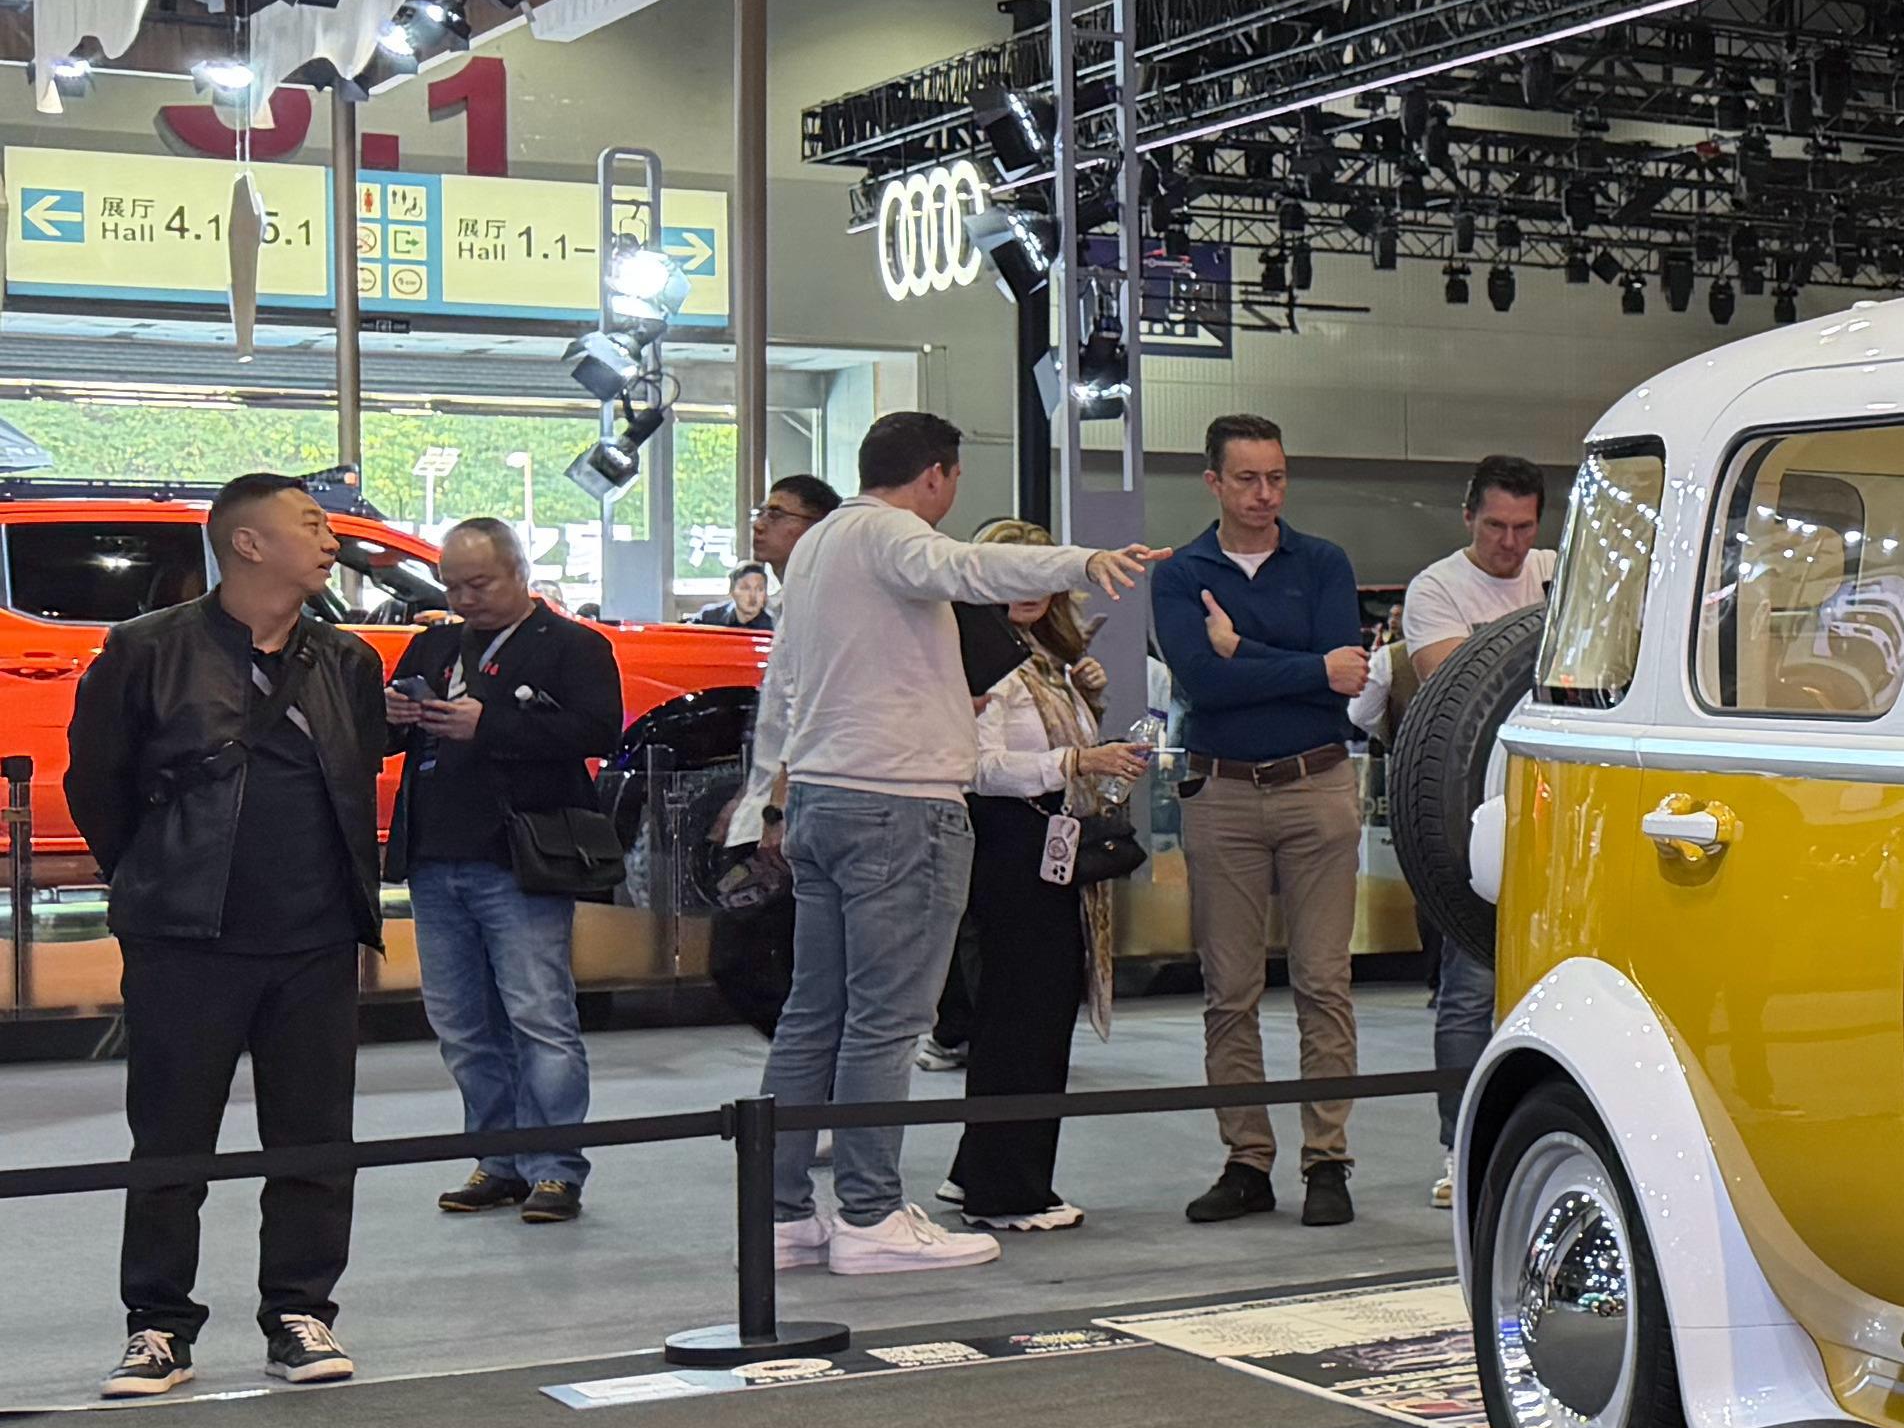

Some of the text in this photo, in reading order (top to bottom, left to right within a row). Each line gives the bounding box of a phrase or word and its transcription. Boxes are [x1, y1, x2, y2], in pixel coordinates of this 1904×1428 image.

[100, 194, 156, 219] 展厅
[101, 219, 155, 243] Hall
[456, 217, 508, 239] 展厅
[457, 240, 507, 262] Hall
